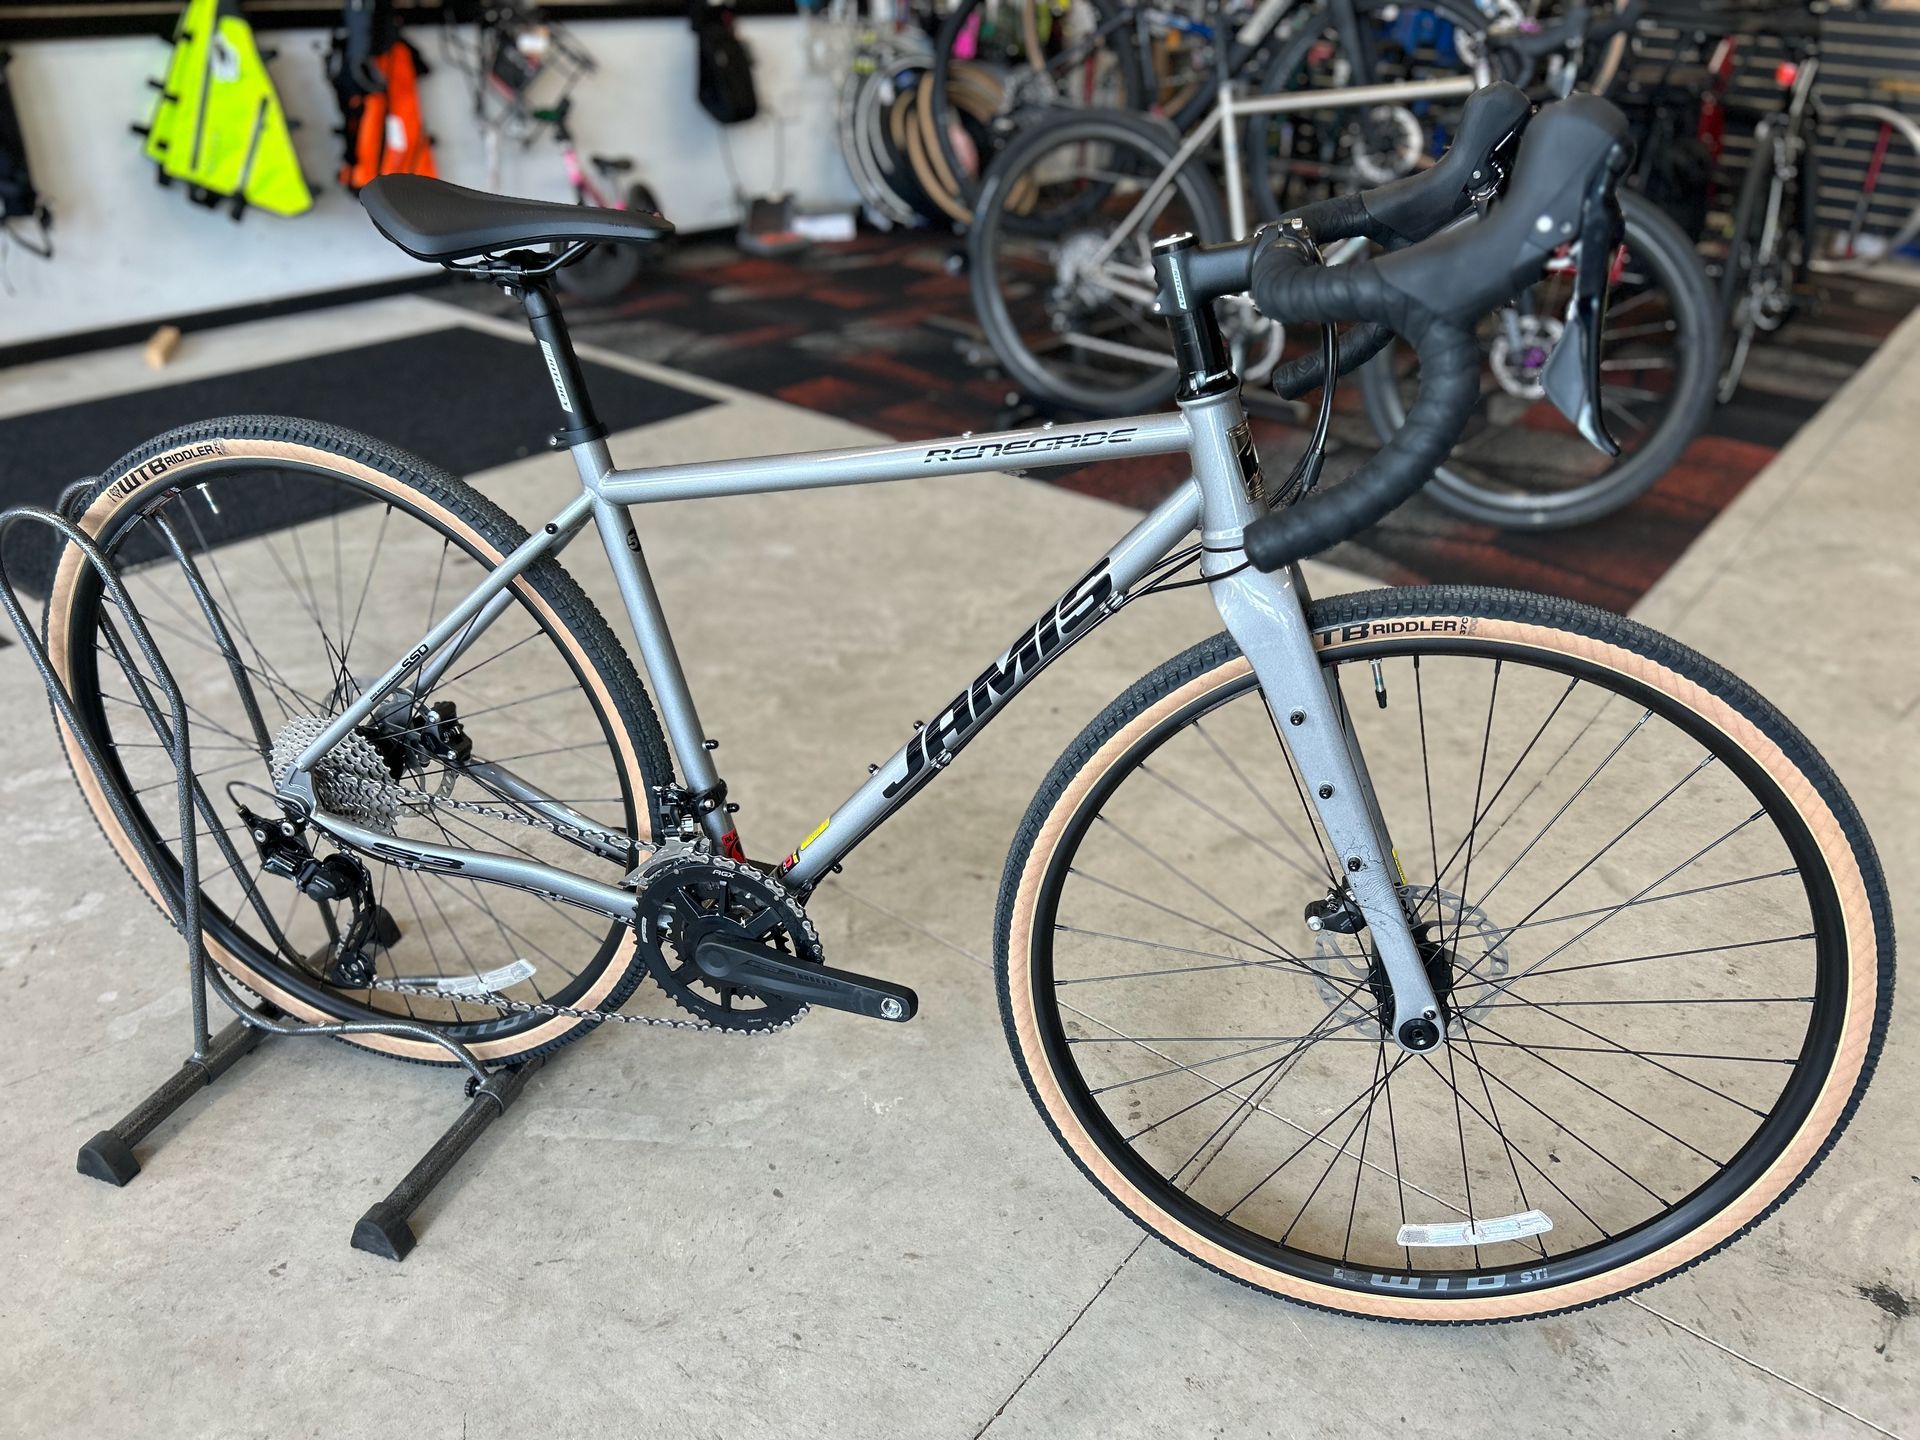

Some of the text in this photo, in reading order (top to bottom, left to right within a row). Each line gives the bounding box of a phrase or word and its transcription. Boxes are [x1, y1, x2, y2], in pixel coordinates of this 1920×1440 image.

[924, 427, 1138, 463] RENEGADE
[116, 444, 216, 494] WTB RIDDLER
[1311, 620, 1458, 647] TB RIDDLER
[401, 643, 430, 669] SSD
[882, 556, 1113, 799] JAMIS
[712, 868, 735, 879] AGX
